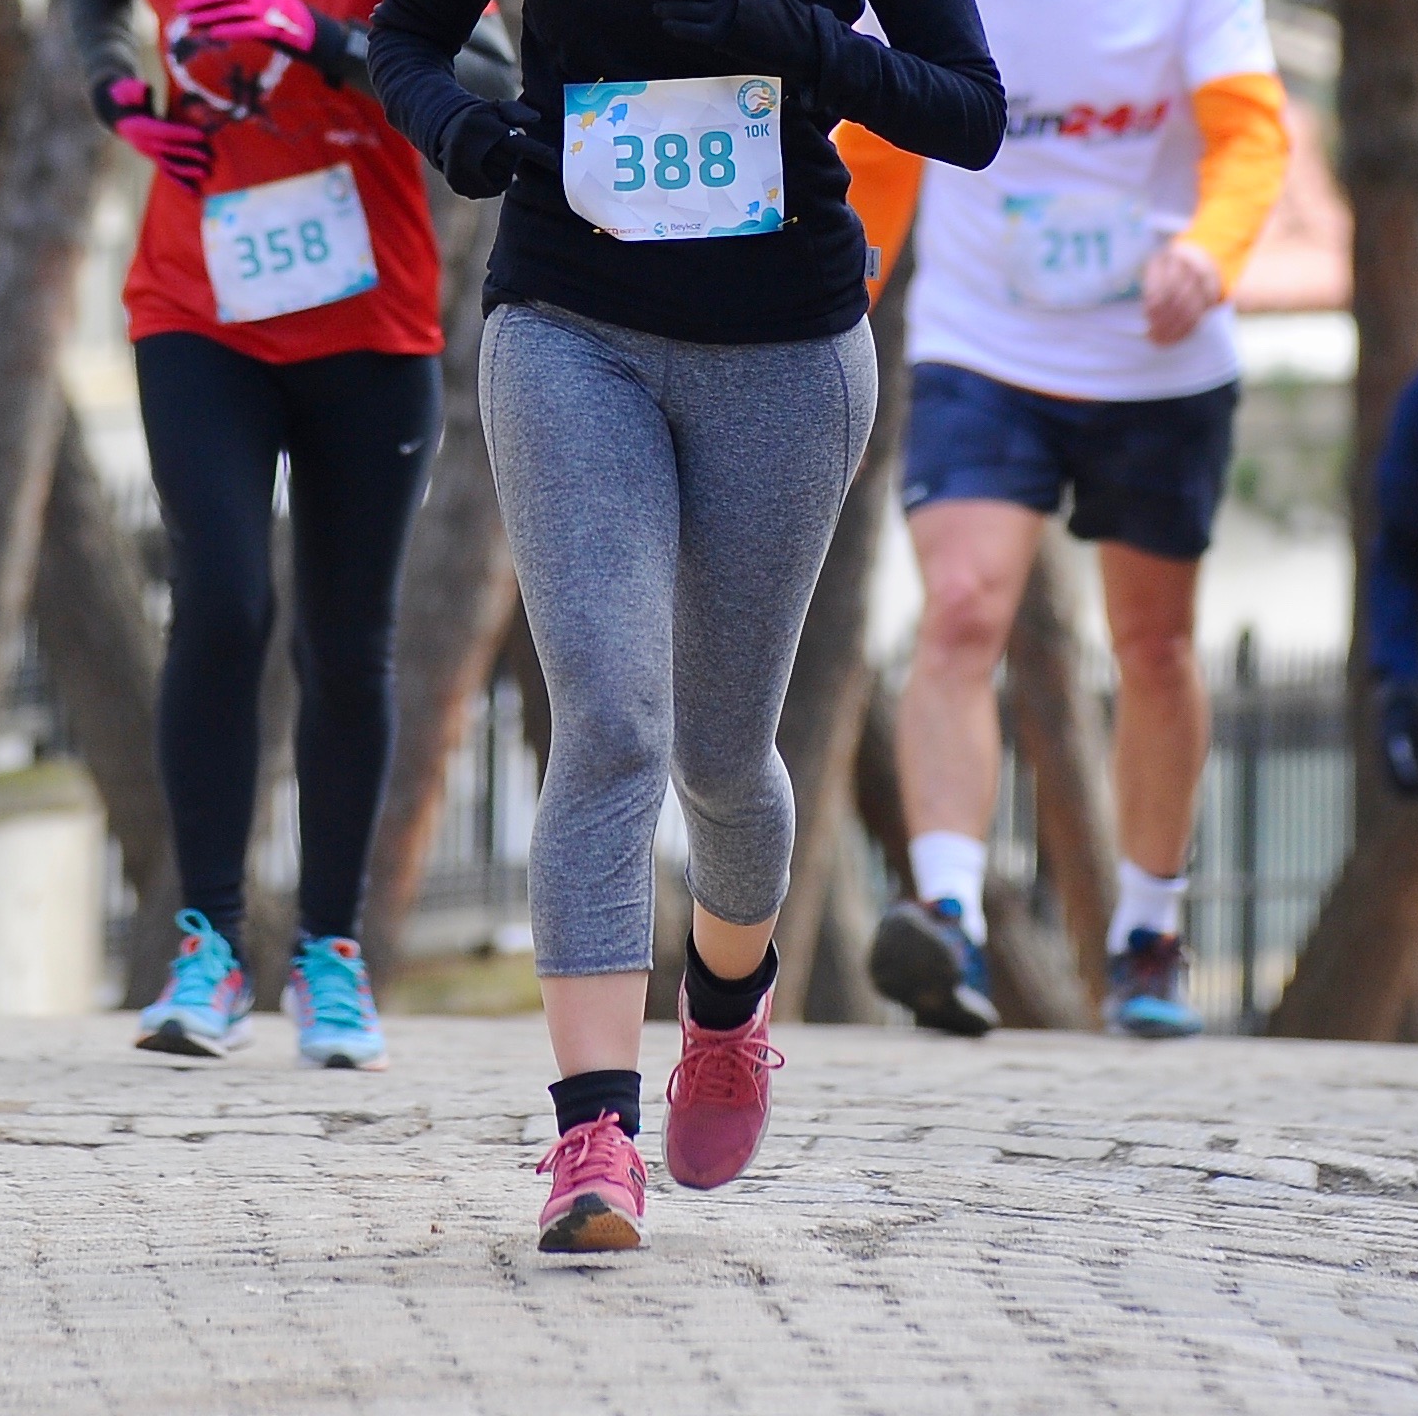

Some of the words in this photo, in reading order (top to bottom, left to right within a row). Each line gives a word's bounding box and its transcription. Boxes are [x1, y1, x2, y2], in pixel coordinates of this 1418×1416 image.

[744, 123, 770, 138] 10K
[613, 130, 736, 192] 388
[670, 222, 701, 232] Beykoz
[235, 219, 330, 280] 358
[1043, 229, 1112, 271] 211
